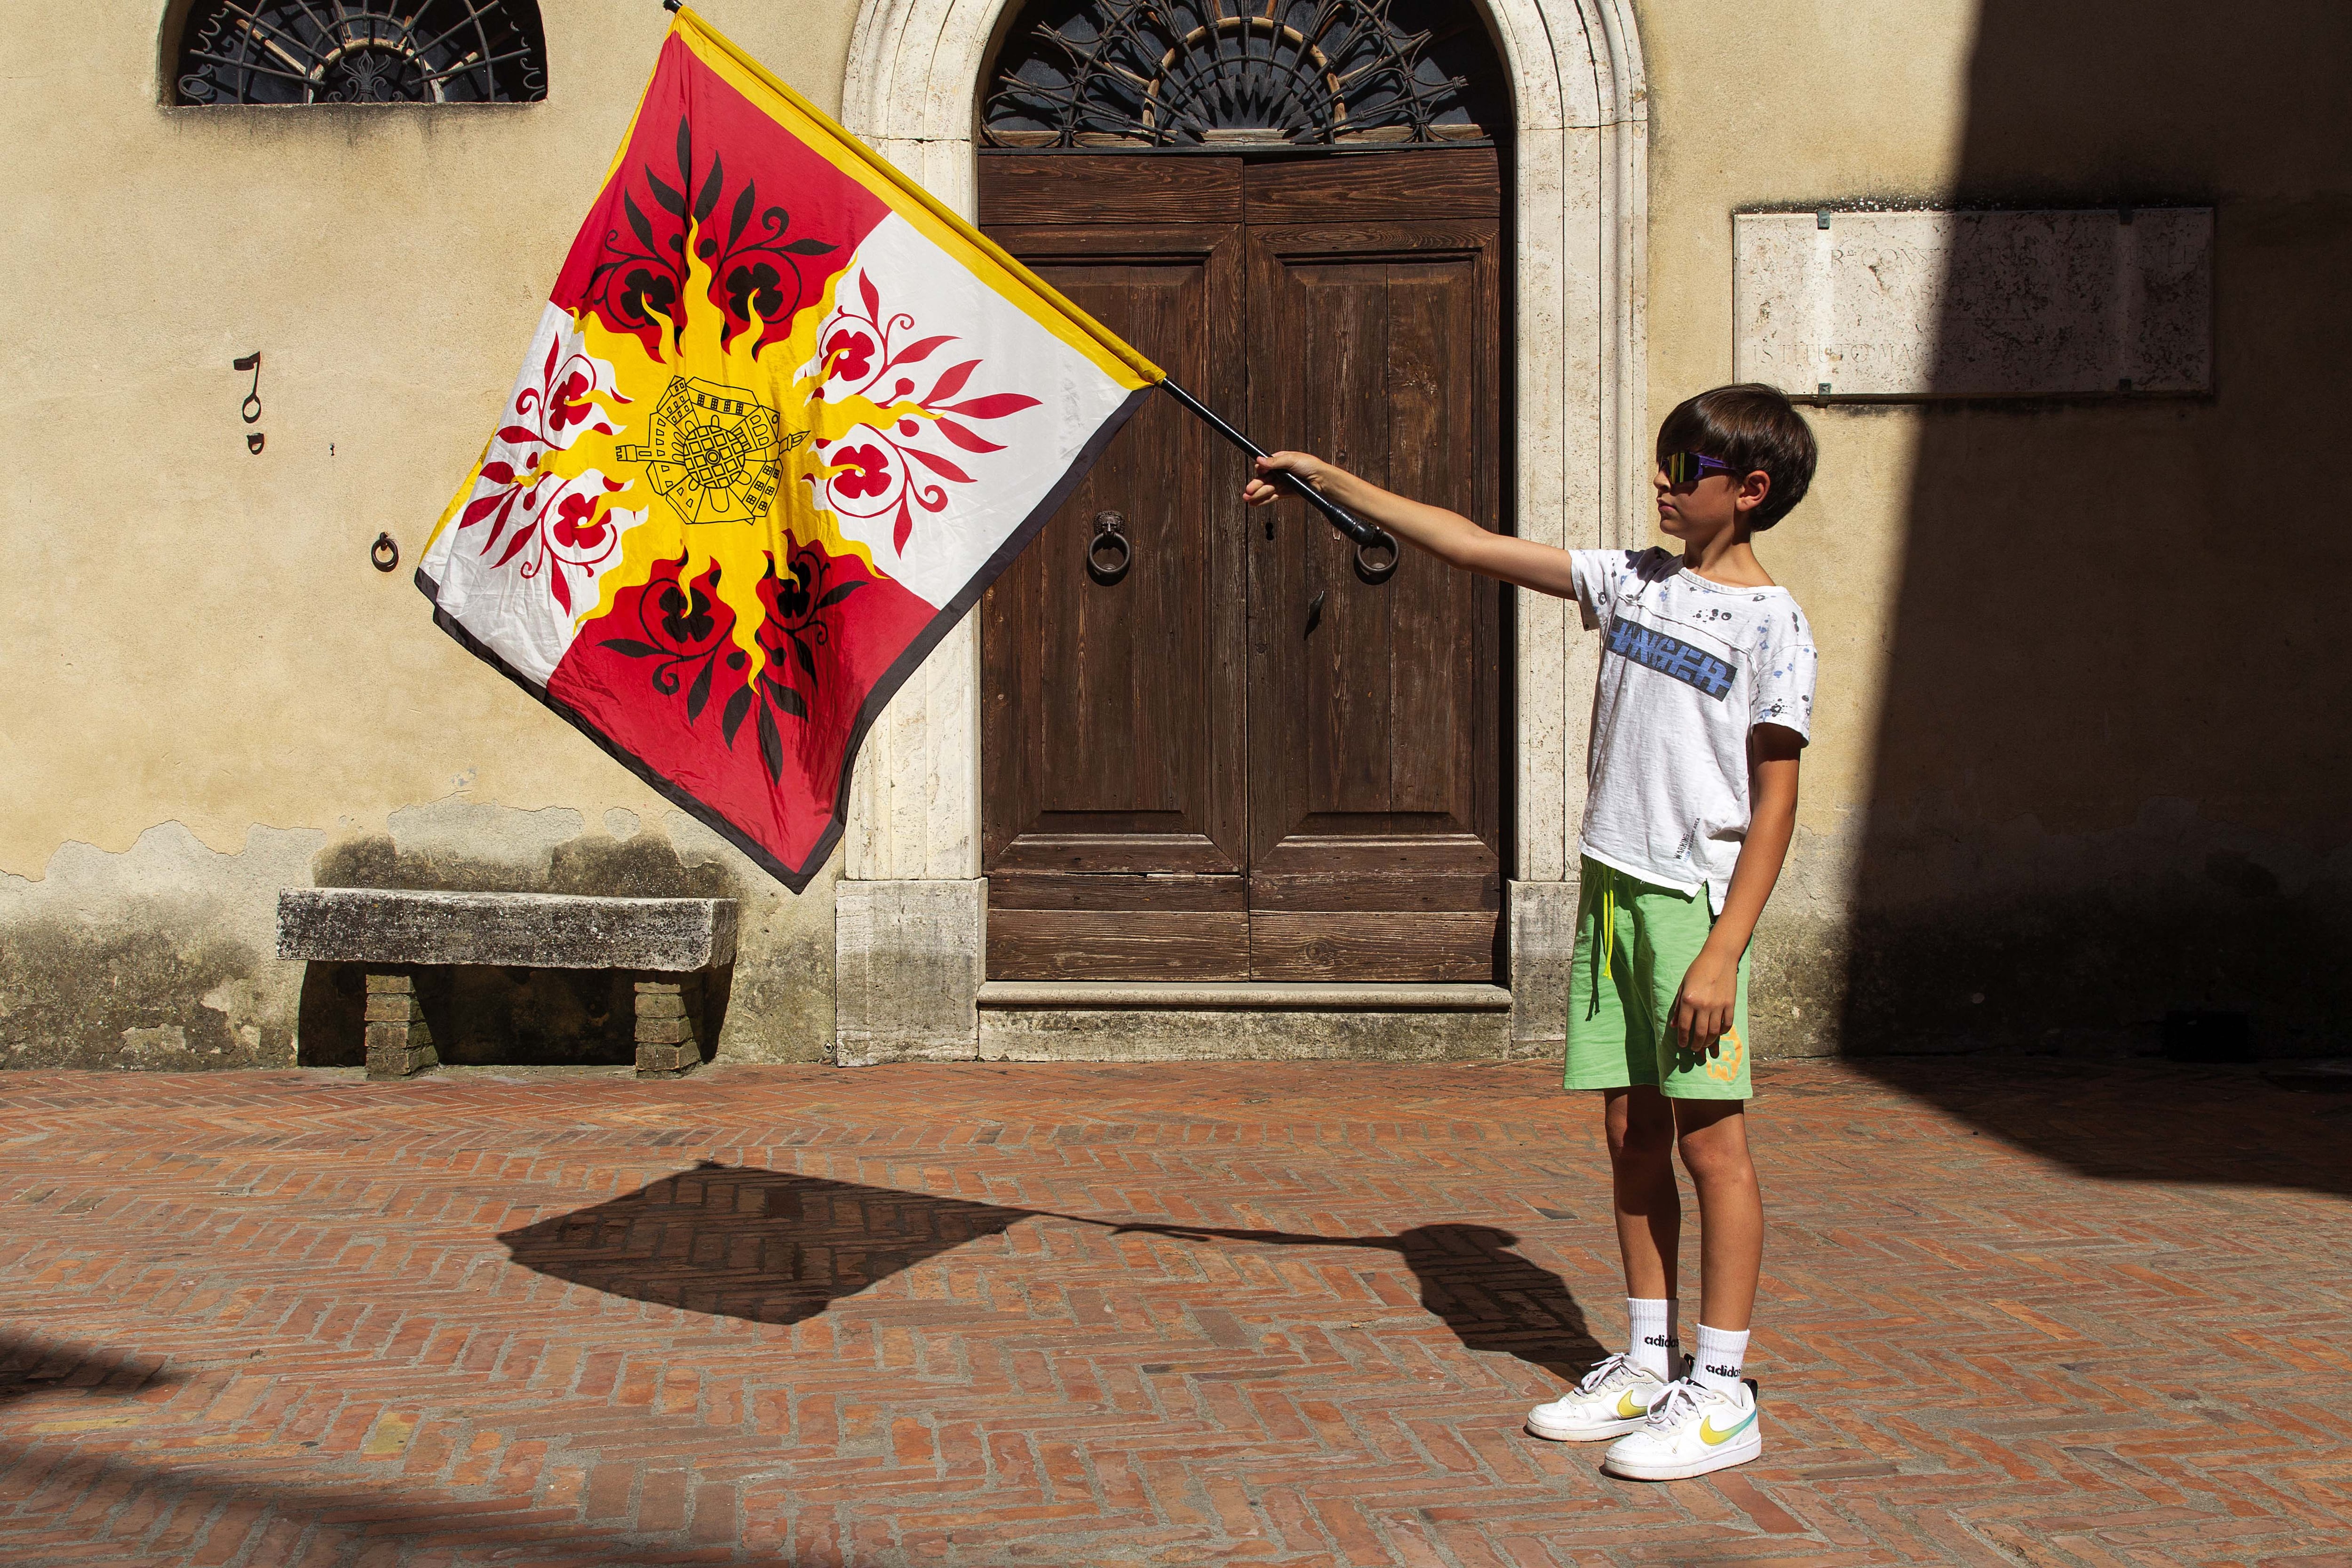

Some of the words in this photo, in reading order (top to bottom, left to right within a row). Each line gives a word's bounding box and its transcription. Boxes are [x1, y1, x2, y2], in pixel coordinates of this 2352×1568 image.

[1754, 344, 1868, 363] ISTITUTO
[1673, 833, 1690, 860] WARNING
[1645, 1335, 1679, 1348] adidas
